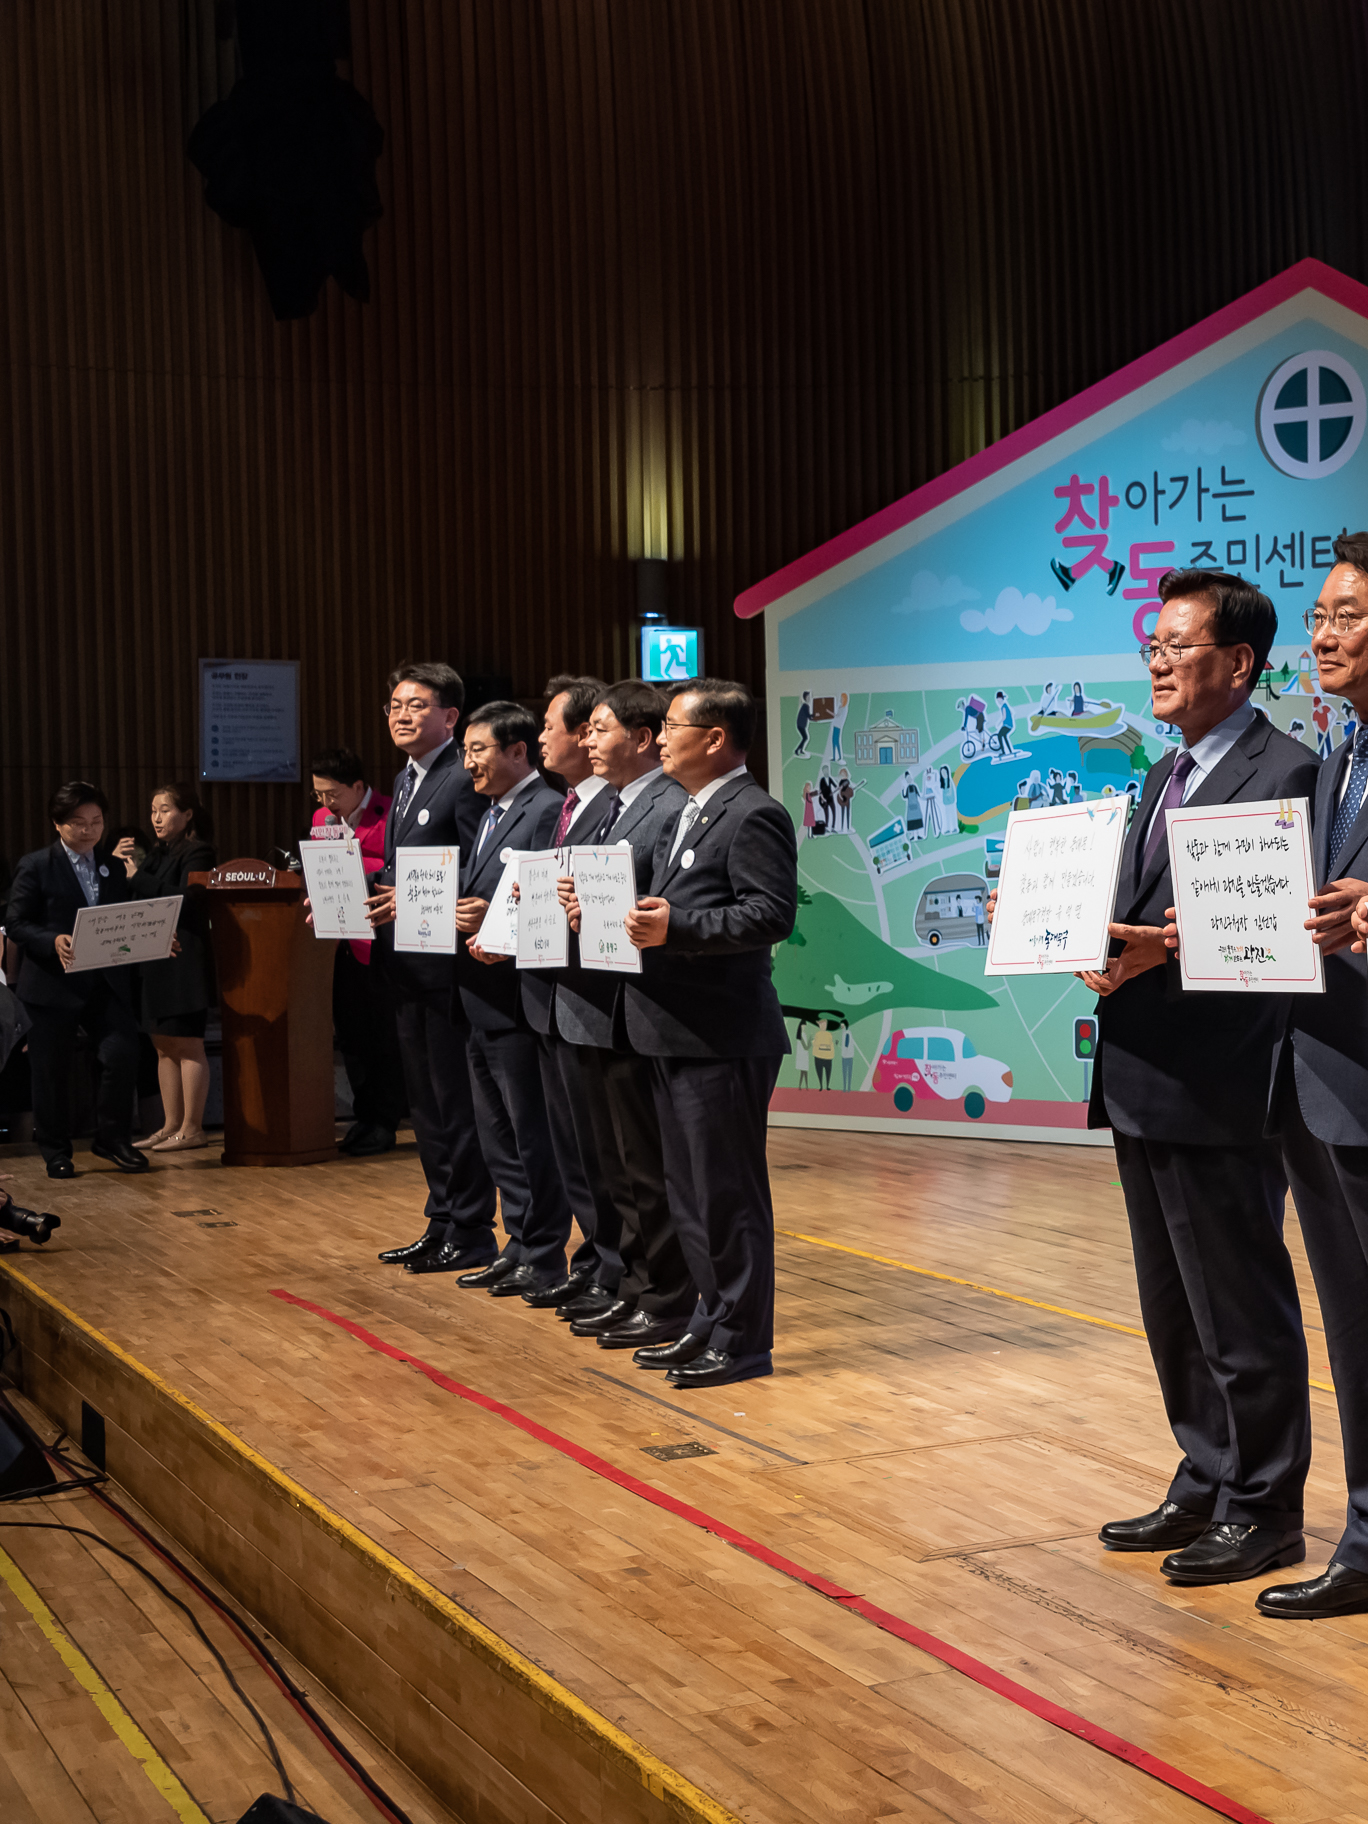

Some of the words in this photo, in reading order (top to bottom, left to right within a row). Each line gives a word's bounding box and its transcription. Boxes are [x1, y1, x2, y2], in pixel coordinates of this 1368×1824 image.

[1051, 465, 1255, 592] 찾아가는
[1186, 839, 1209, 861] 찾동과
[1213, 838, 1231, 856] 함께
[1235, 837, 1254, 855] 구민이
[1259, 836, 1289, 852] 하나되는
[1223, 875, 1245, 898] 광진을
[1211, 913, 1248, 932] 광진구청장
[1254, 913, 1277, 931] 김선갑
[1244, 944, 1266, 963] 광진
